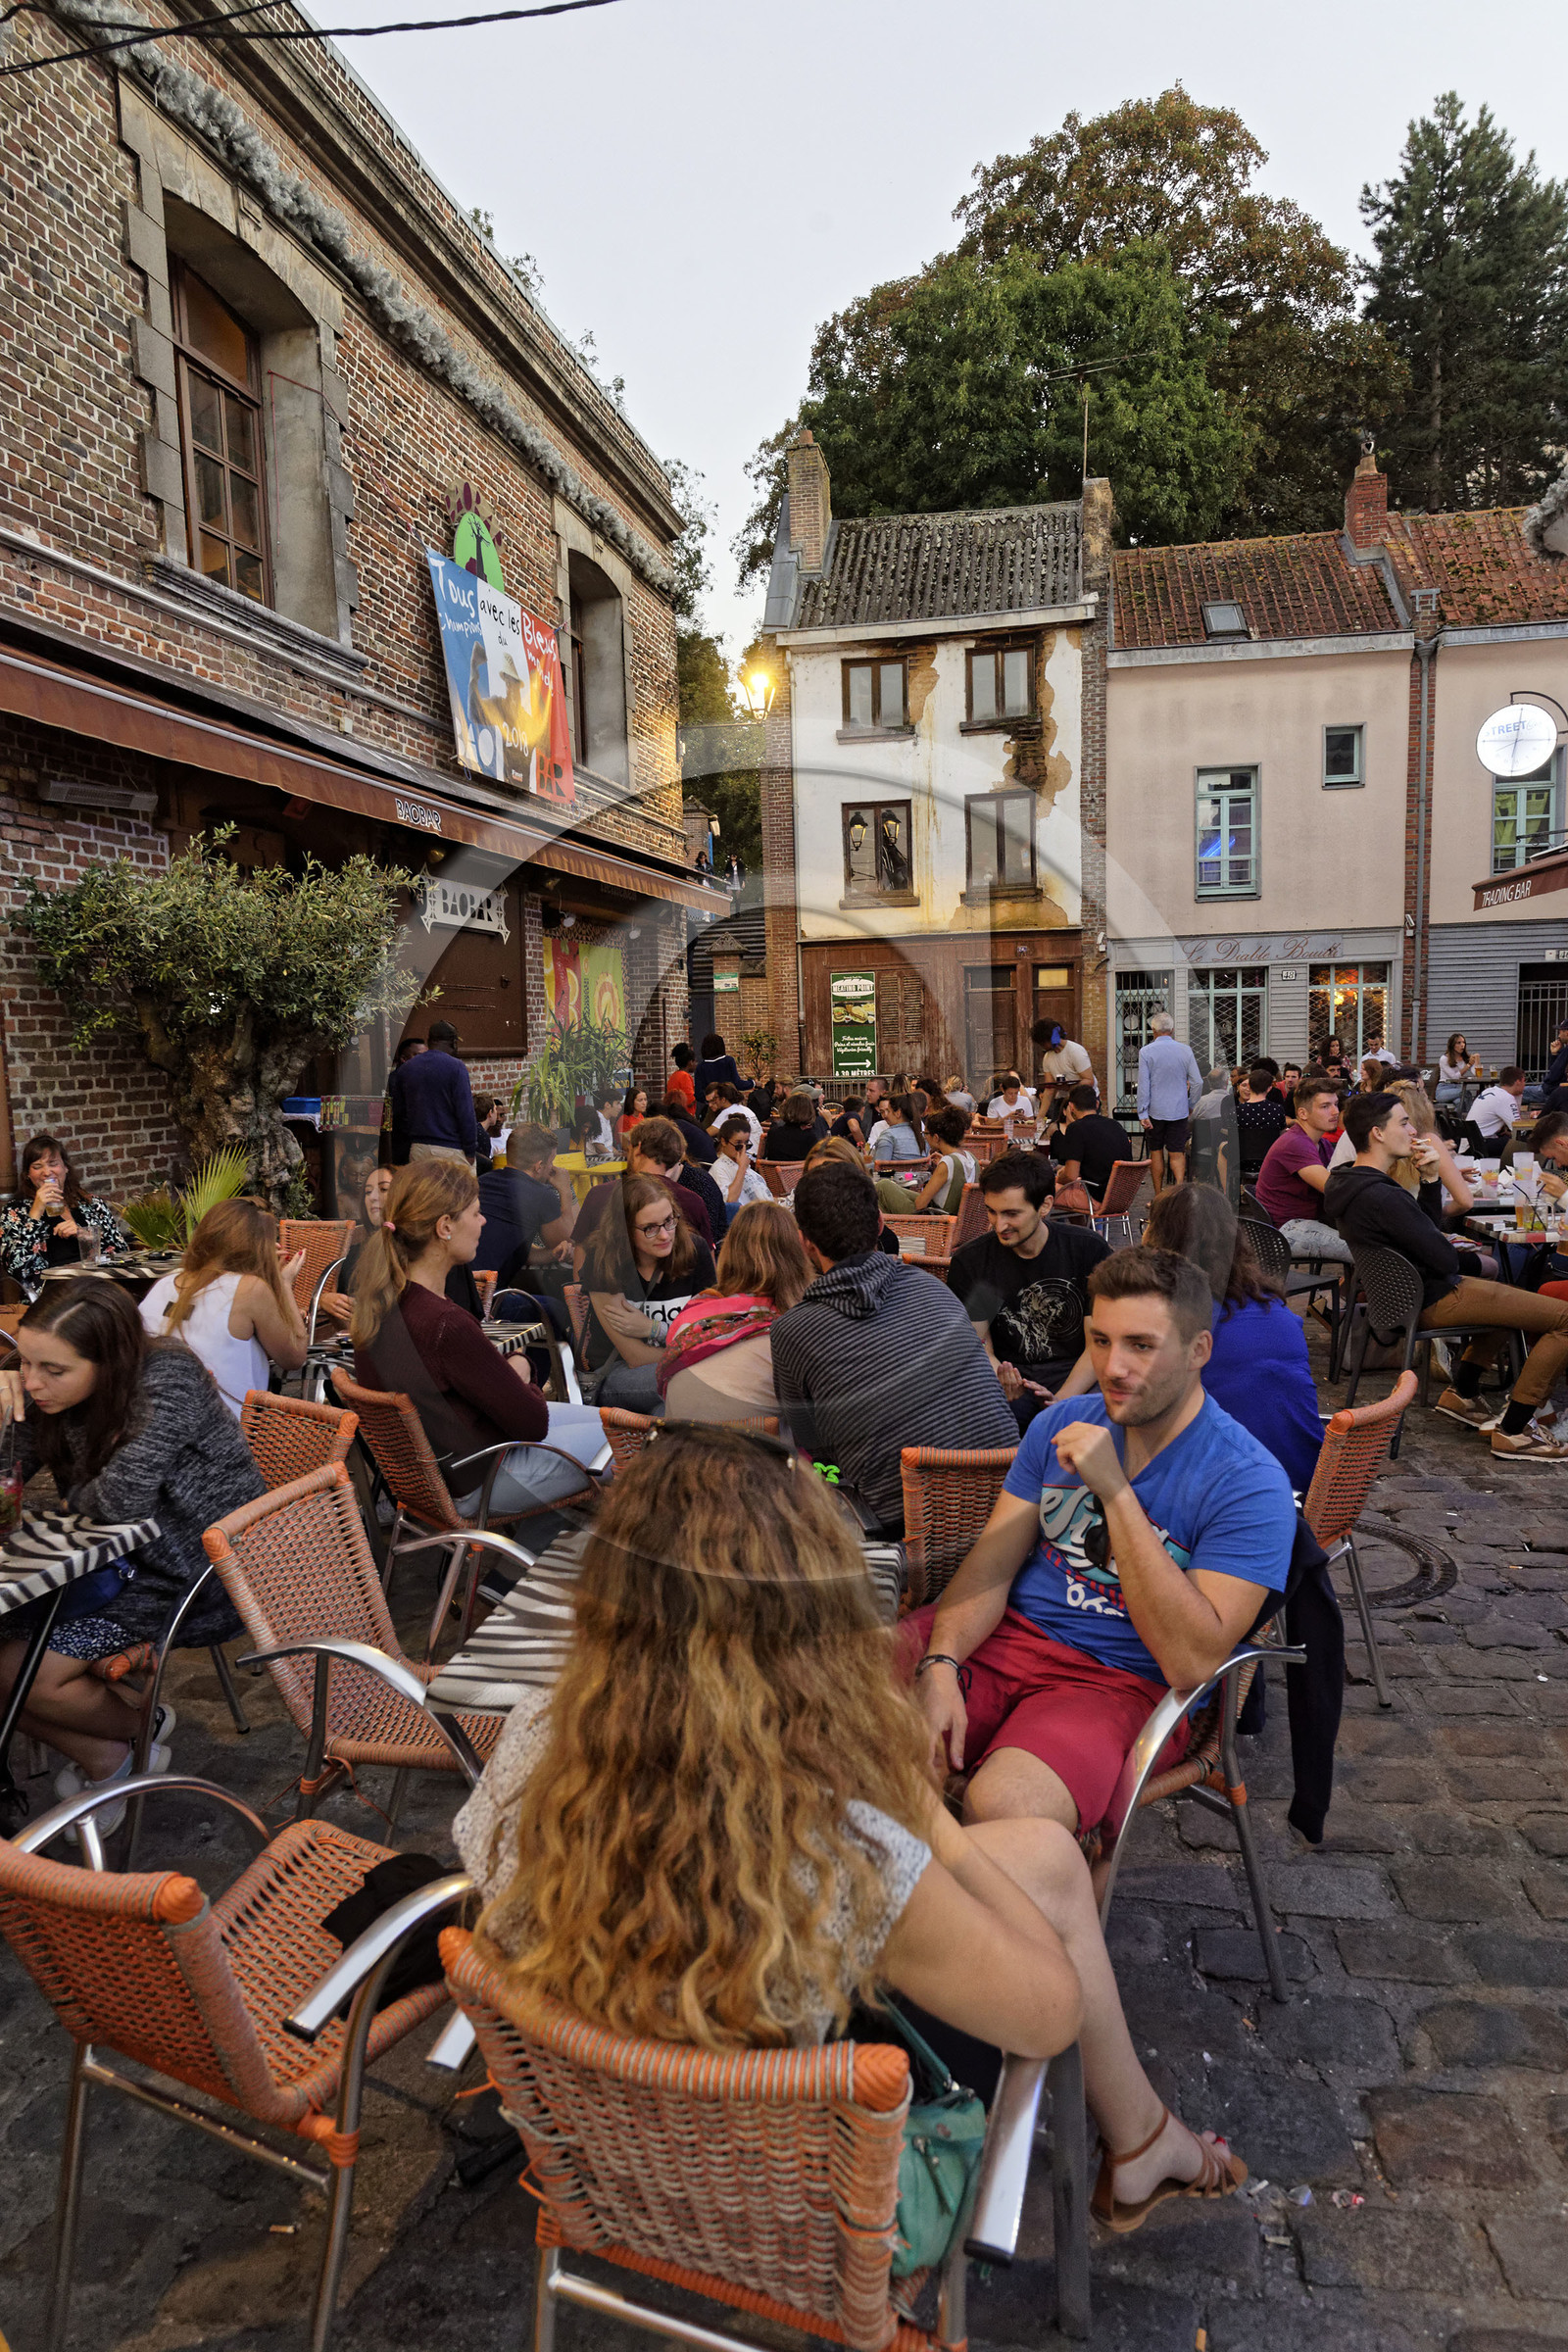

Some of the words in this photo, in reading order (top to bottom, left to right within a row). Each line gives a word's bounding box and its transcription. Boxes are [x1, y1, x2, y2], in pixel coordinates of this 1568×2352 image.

[429, 557, 476, 619] Tous
[479, 599, 505, 626] avec
[508, 608, 521, 636] les
[521, 611, 558, 662] Bleus
[497, 630, 509, 647] du
[502, 720, 529, 758] 2018
[1486, 719, 1527, 736] TREET
[394, 797, 443, 832] BAOBAR
[441, 888, 494, 923] BAOBAR
[1481, 884, 1515, 907] TRADING
[1514, 879, 1532, 901] BAR
[1180, 939, 1208, 963] Le
[1211, 938, 1272, 962] Diable
[1283, 970, 1295, 979] 48
